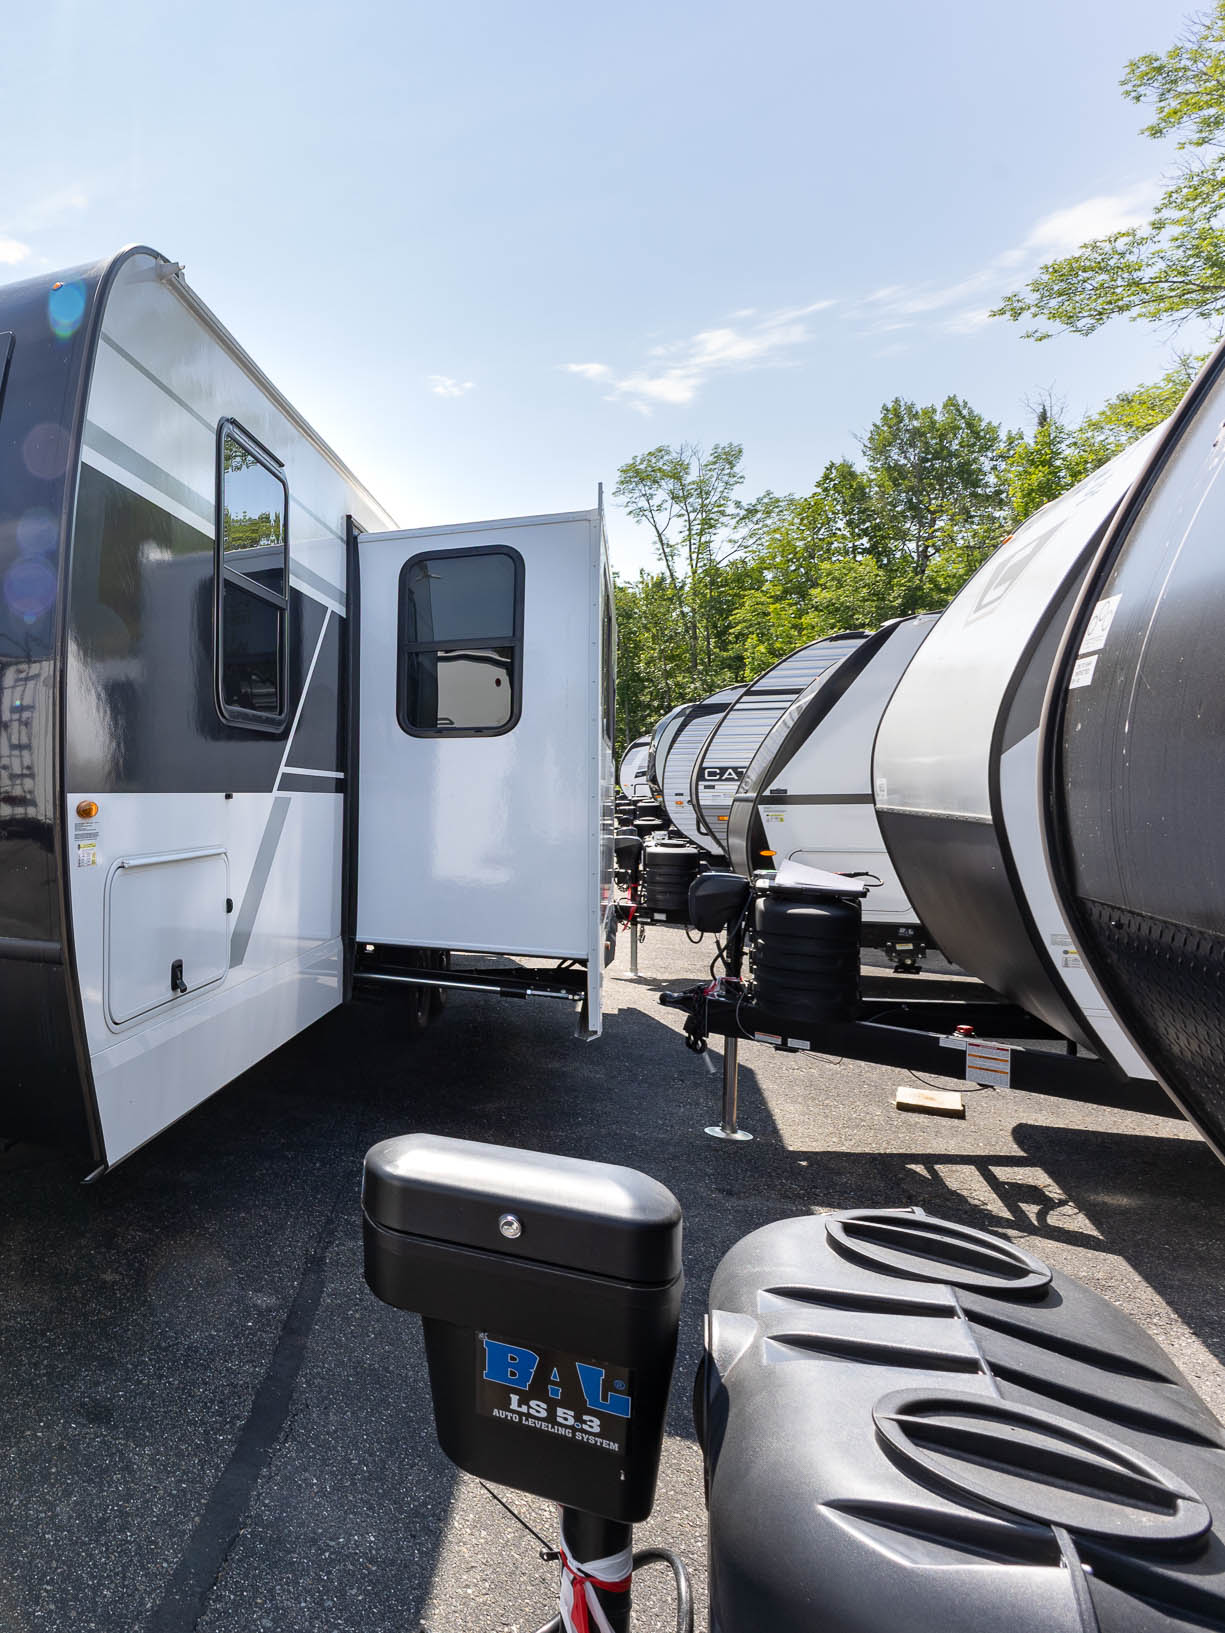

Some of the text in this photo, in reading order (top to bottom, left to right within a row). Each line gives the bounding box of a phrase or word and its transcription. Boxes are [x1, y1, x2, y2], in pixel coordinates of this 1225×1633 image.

[482, 1338, 632, 1419] BAL
[492, 1408, 619, 1452] AUTO LEVELING SYSTEM
[509, 1393, 601, 1433] LS 5.3
